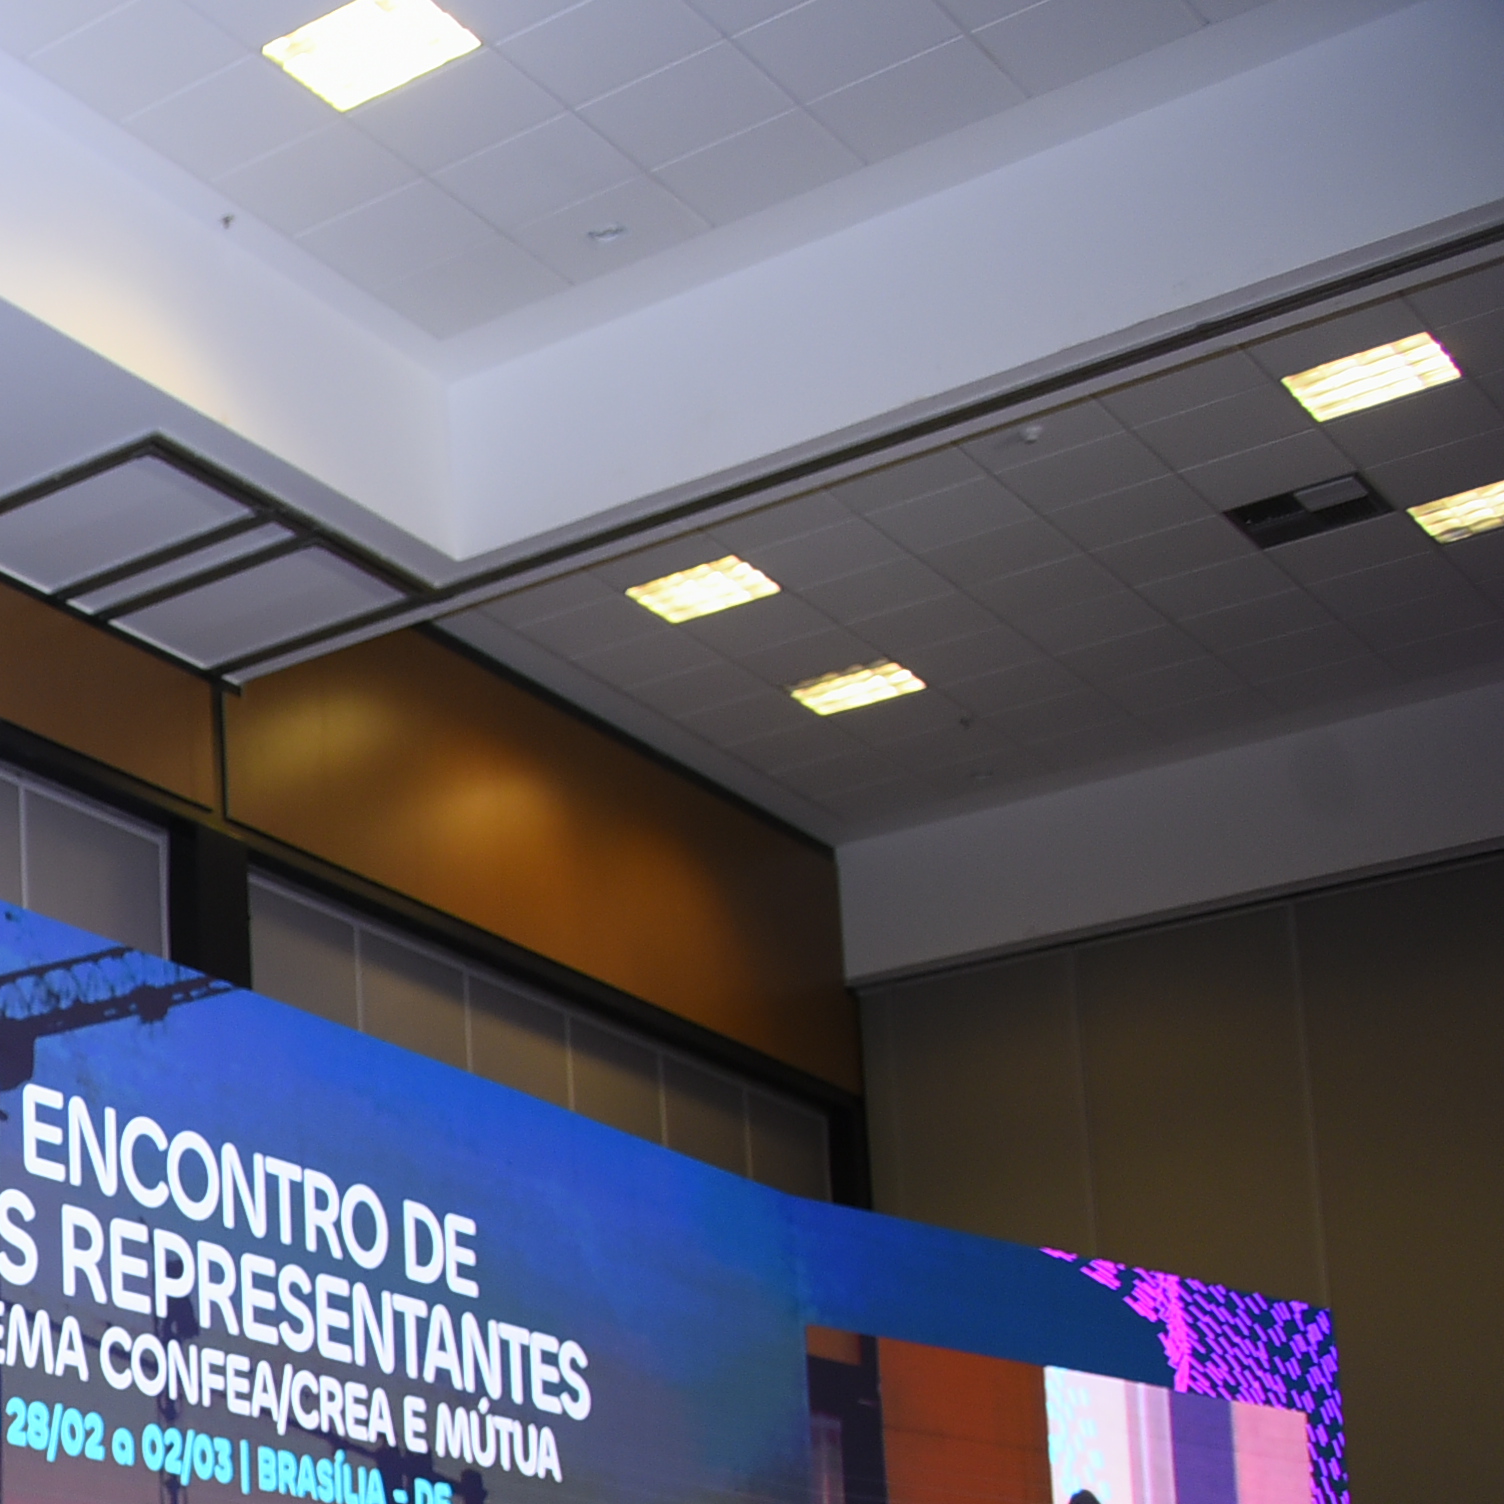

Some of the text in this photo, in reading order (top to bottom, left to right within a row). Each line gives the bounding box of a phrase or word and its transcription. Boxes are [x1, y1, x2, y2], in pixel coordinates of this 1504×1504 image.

[22, 1083, 389, 1269] ENCONTRO
[403, 1199, 479, 1298] DE
[61, 1203, 592, 1421] REPRESENTANTES
[99, 1326, 396, 1447] CONFEA/CREA
[403, 1395, 428, 1454] E
[435, 1396, 562, 1484] MÚTUA
[5, 1396, 106, 1463] 28/02
[111, 1427, 135, 1467] a
[141, 1423, 234, 1486] 02/03
